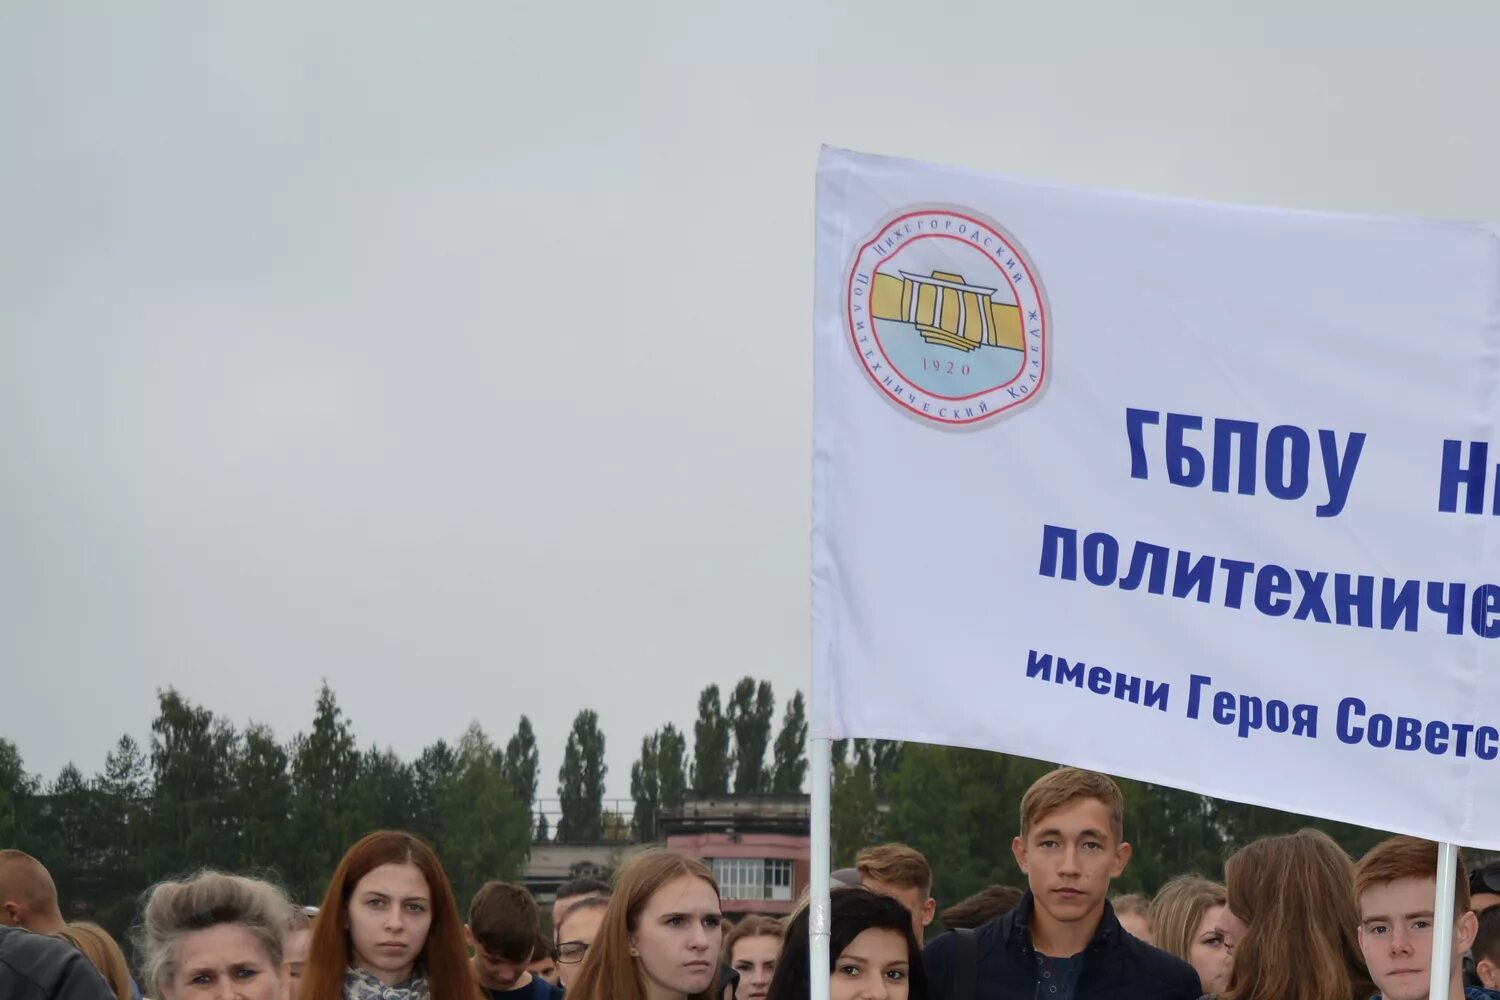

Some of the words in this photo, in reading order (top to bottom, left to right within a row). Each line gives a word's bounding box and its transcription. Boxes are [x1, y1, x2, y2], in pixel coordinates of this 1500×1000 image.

[922, 358, 970, 376] 1920
[1125, 408, 1366, 517] ГБПОУ
[1026, 650, 1170, 711] имени
[1187, 674, 1318, 739] Героя
